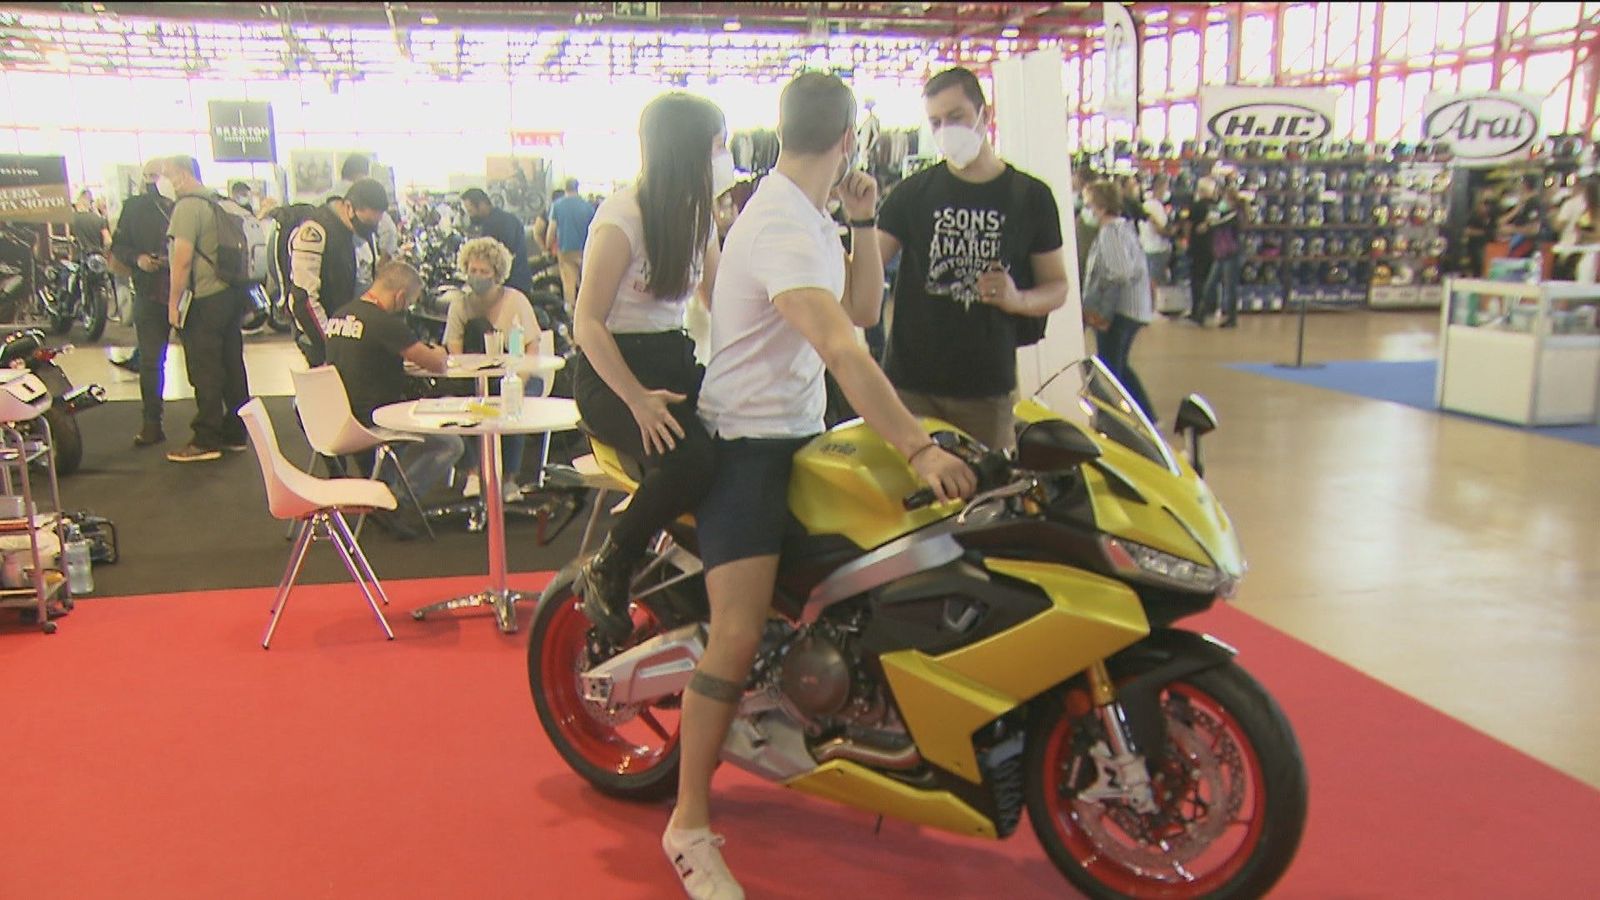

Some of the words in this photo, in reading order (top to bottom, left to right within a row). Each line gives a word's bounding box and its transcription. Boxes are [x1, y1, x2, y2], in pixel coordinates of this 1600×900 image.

[1224, 116, 1316, 136] HJC
[1432, 105, 1528, 139] Arai
[943, 207, 1000, 231] SONS
